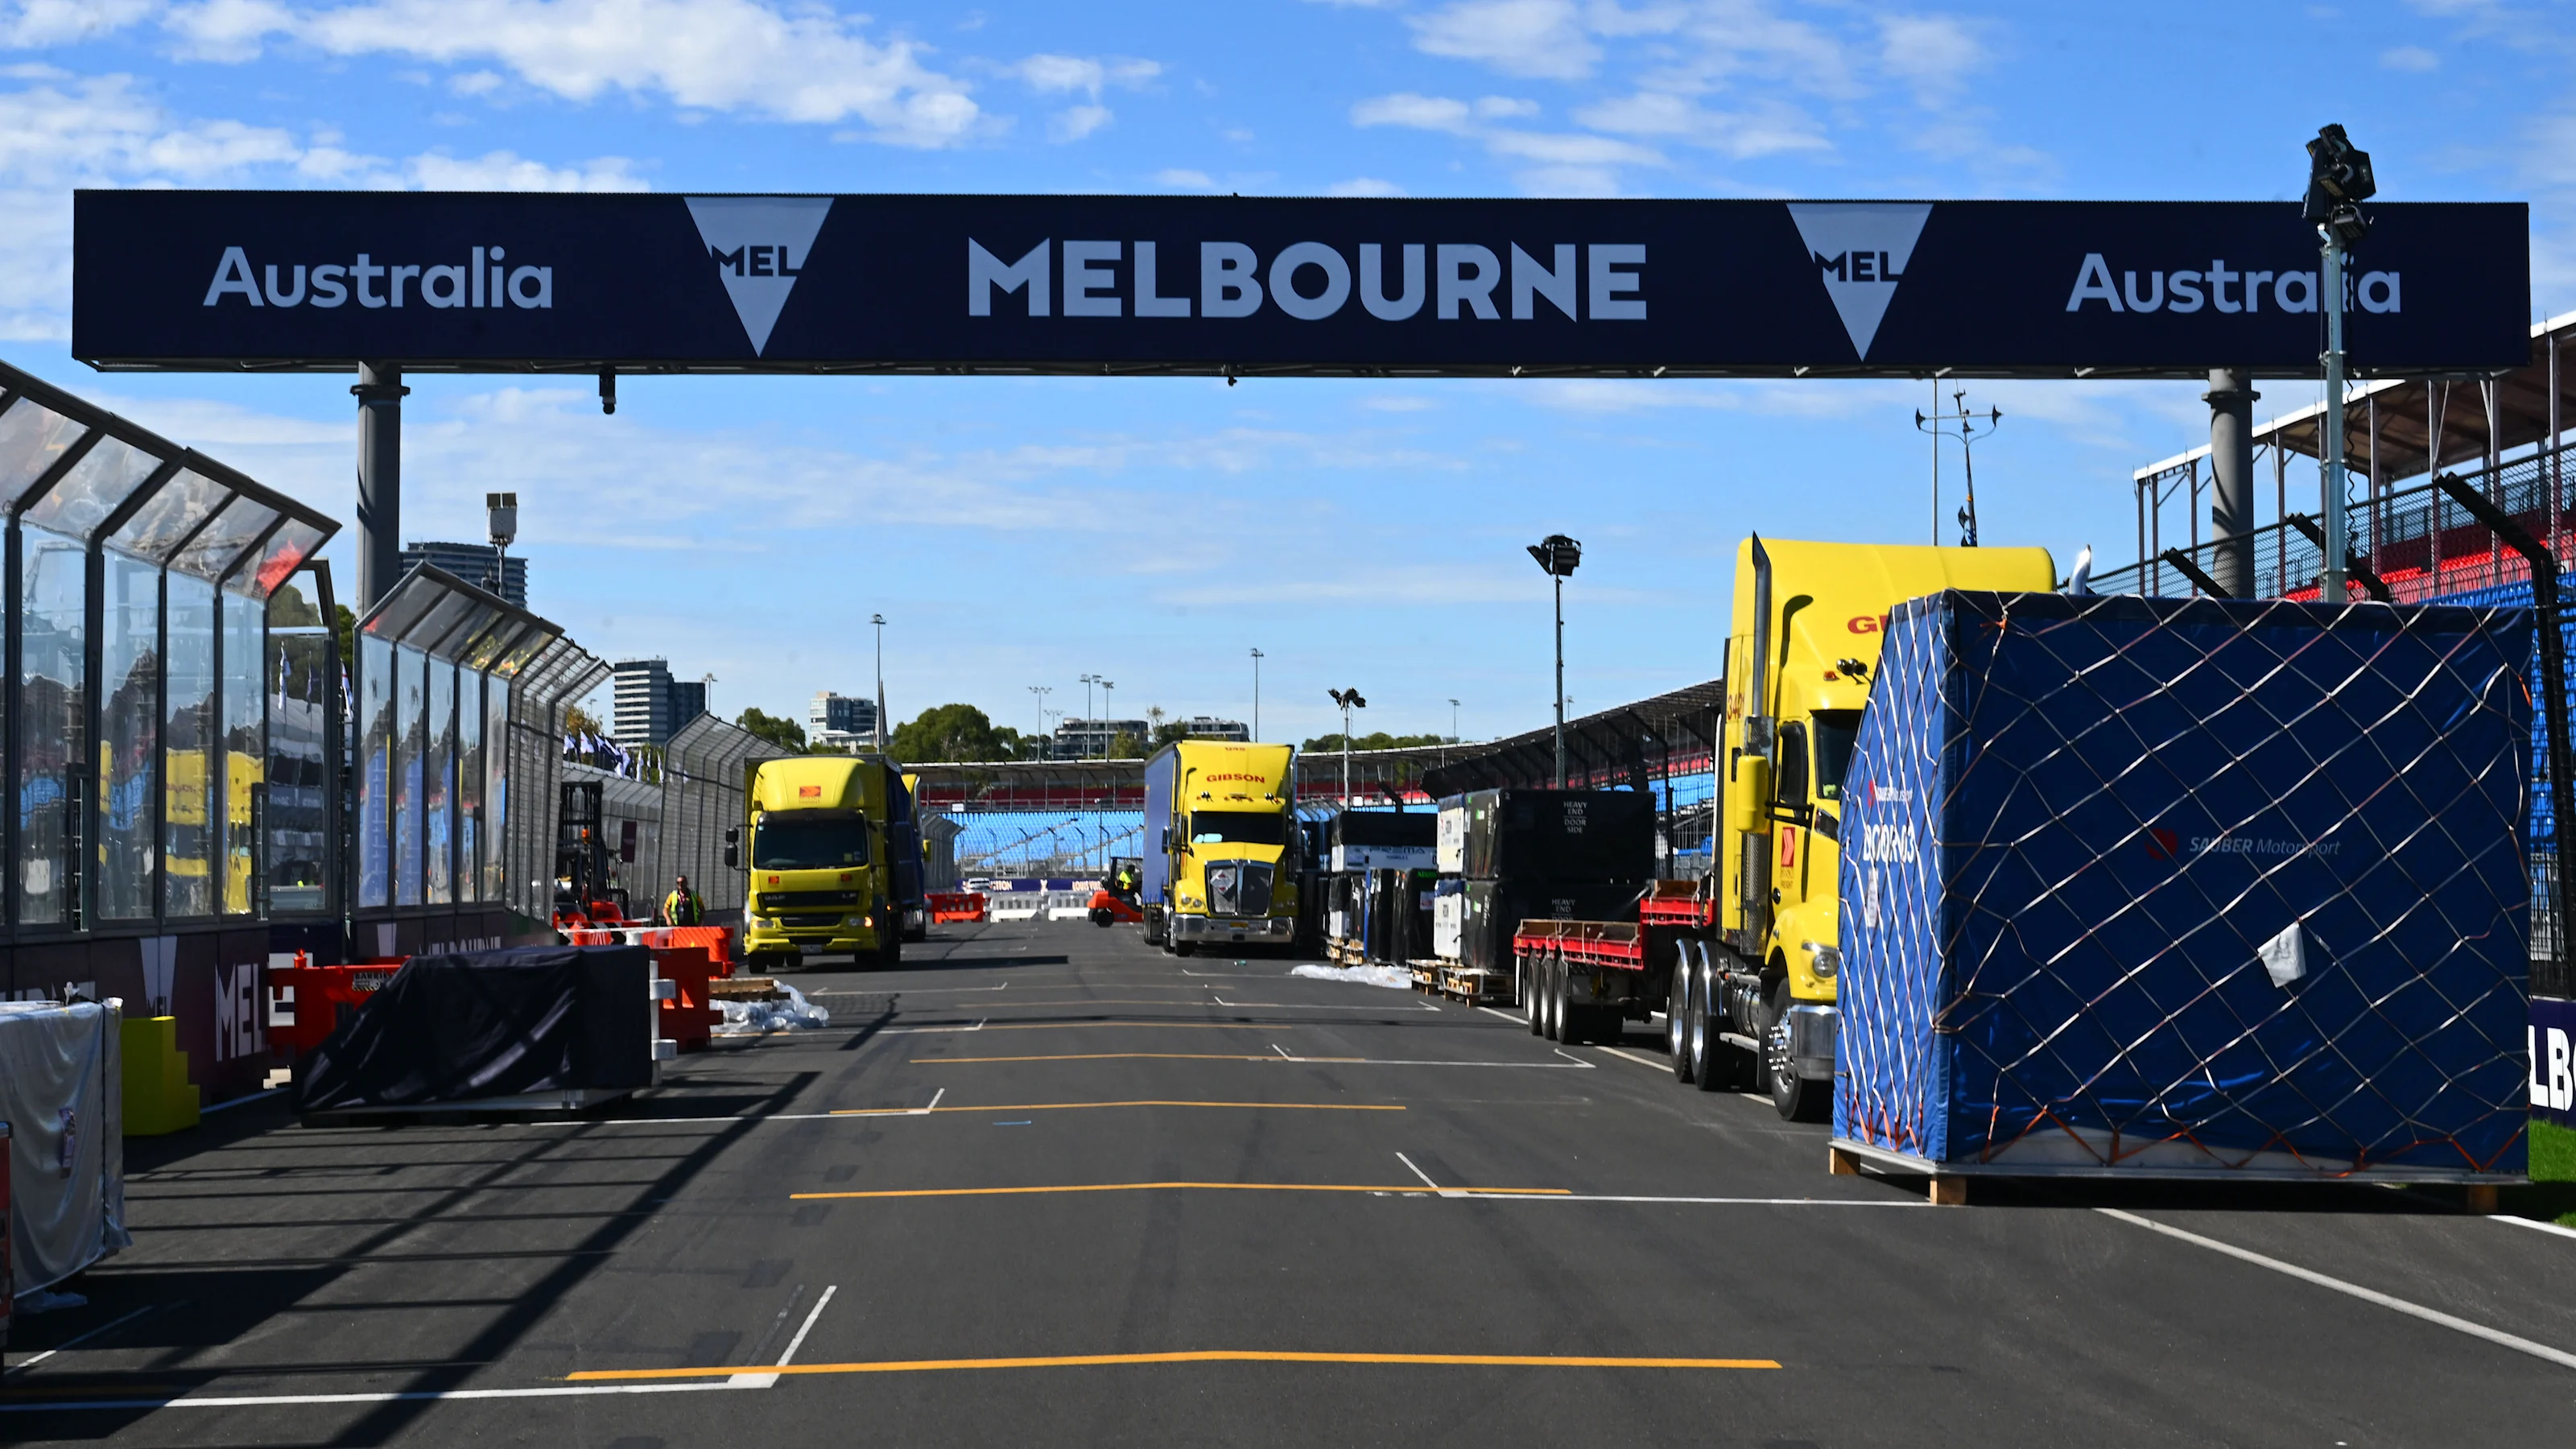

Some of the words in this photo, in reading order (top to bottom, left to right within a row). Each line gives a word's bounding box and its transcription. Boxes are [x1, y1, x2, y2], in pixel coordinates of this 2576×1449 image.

[204, 246, 552, 308] Australia
[712, 245, 803, 277] MEL
[1814, 250, 1903, 283] MEL
[968, 237, 1646, 322] MELBOURNE
[1206, 774, 1265, 784] GIBSON
[2190, 837, 2253, 853] SAUBER
[2256, 840, 2342, 858] Motorsport
[1552, 898, 1575, 906] HEAVY
[2528, 1025, 2576, 1112] LB
